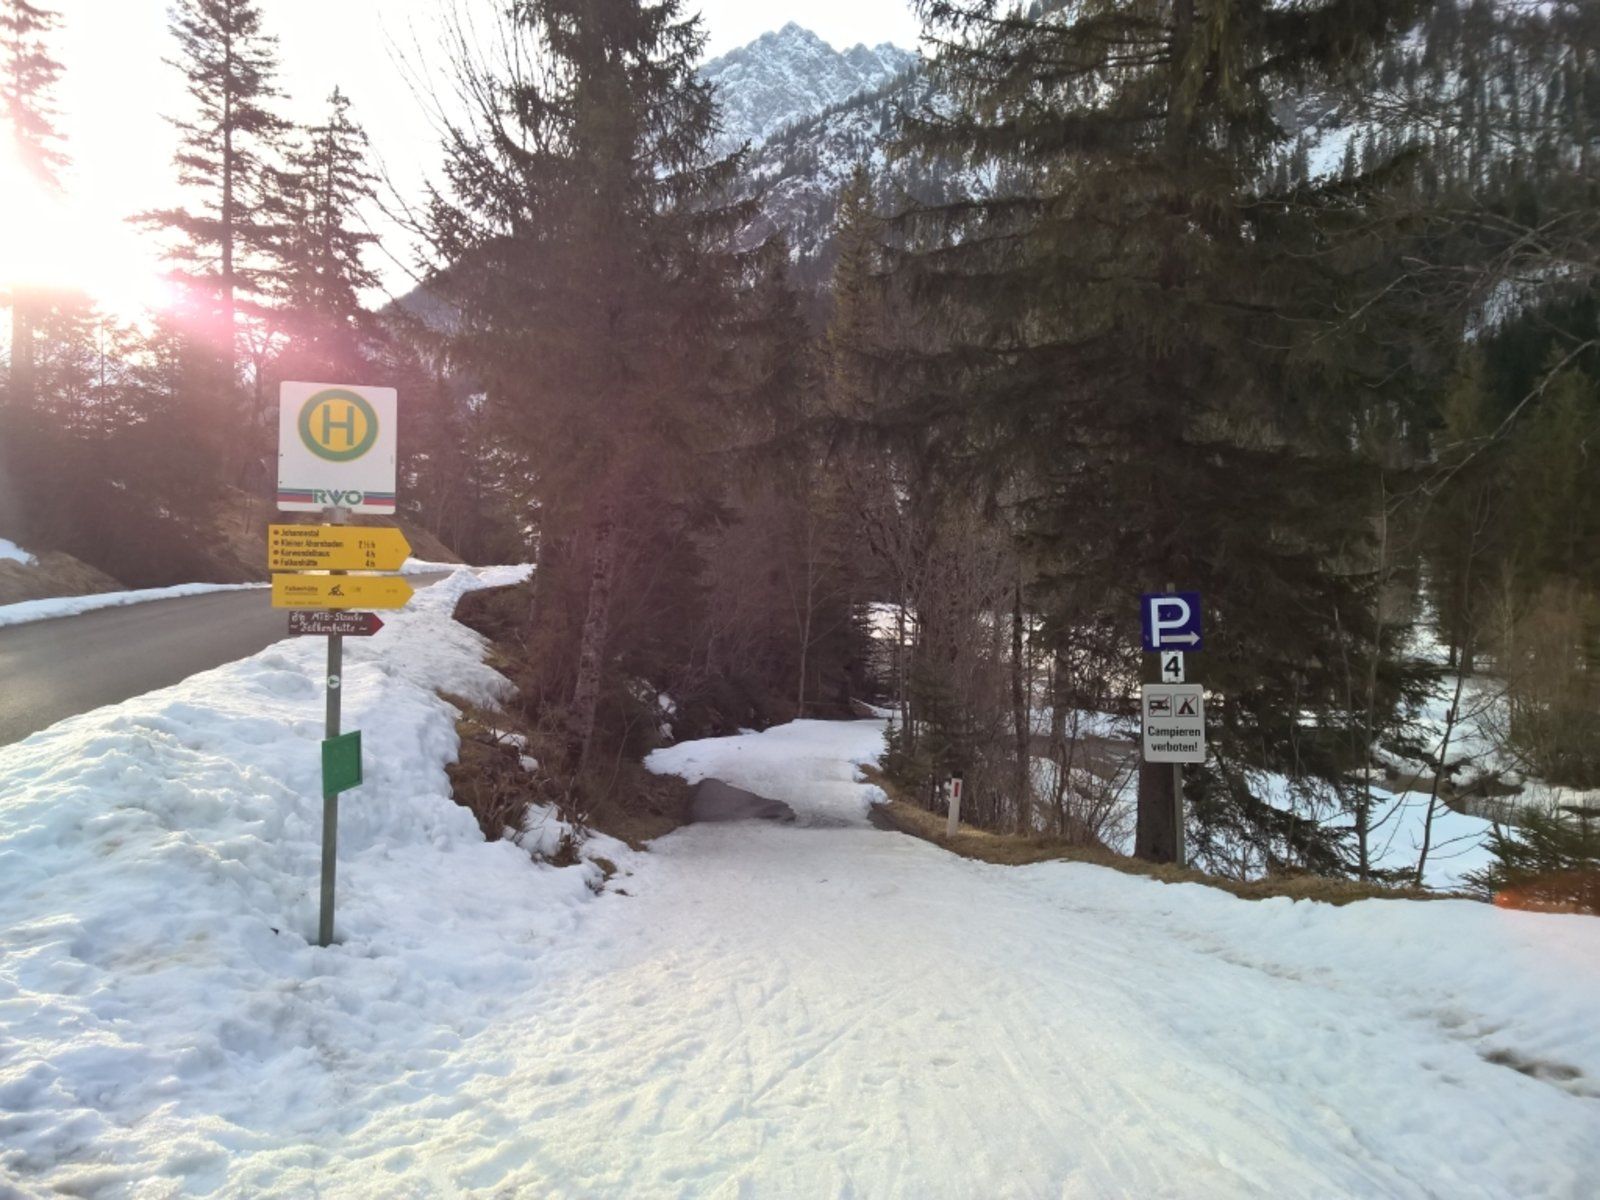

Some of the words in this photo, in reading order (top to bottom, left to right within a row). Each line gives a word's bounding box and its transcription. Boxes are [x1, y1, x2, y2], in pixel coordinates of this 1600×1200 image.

[322, 404, 354, 446] H
[312, 488, 364, 506] RVO
[280, 538, 304, 546] Kleiner
[1150, 597, 1191, 647] P
[1164, 655, 1181, 678] 4
[1147, 726, 1201, 738] Campieren
[1151, 741, 1198, 753] verboten!
